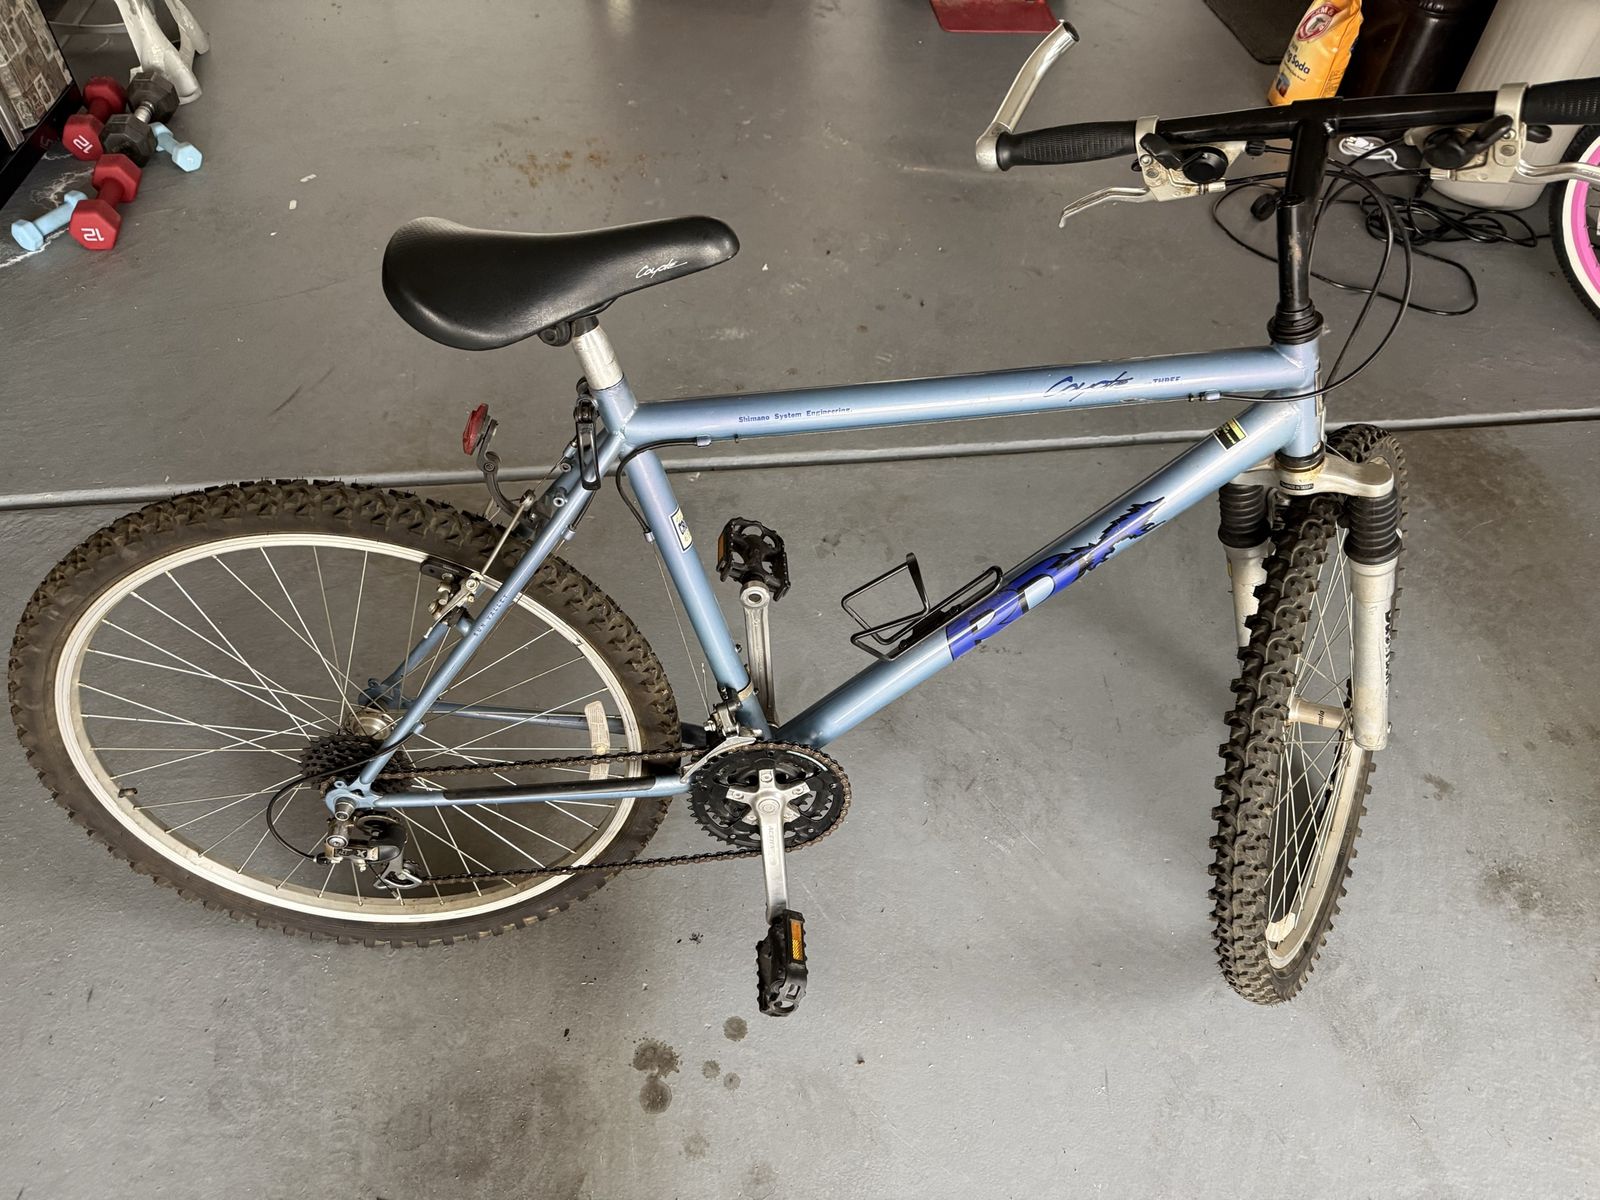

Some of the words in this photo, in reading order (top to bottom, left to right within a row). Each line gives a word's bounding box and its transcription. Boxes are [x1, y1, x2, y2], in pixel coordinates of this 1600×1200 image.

[1292, 54, 1310, 74] Soda
[73, 135, 93, 154] 12
[81, 227, 105, 242] 12
[738, 414, 770, 423] Shimano
[774, 412, 802, 421] System
[806, 407, 851, 418] Engineering
